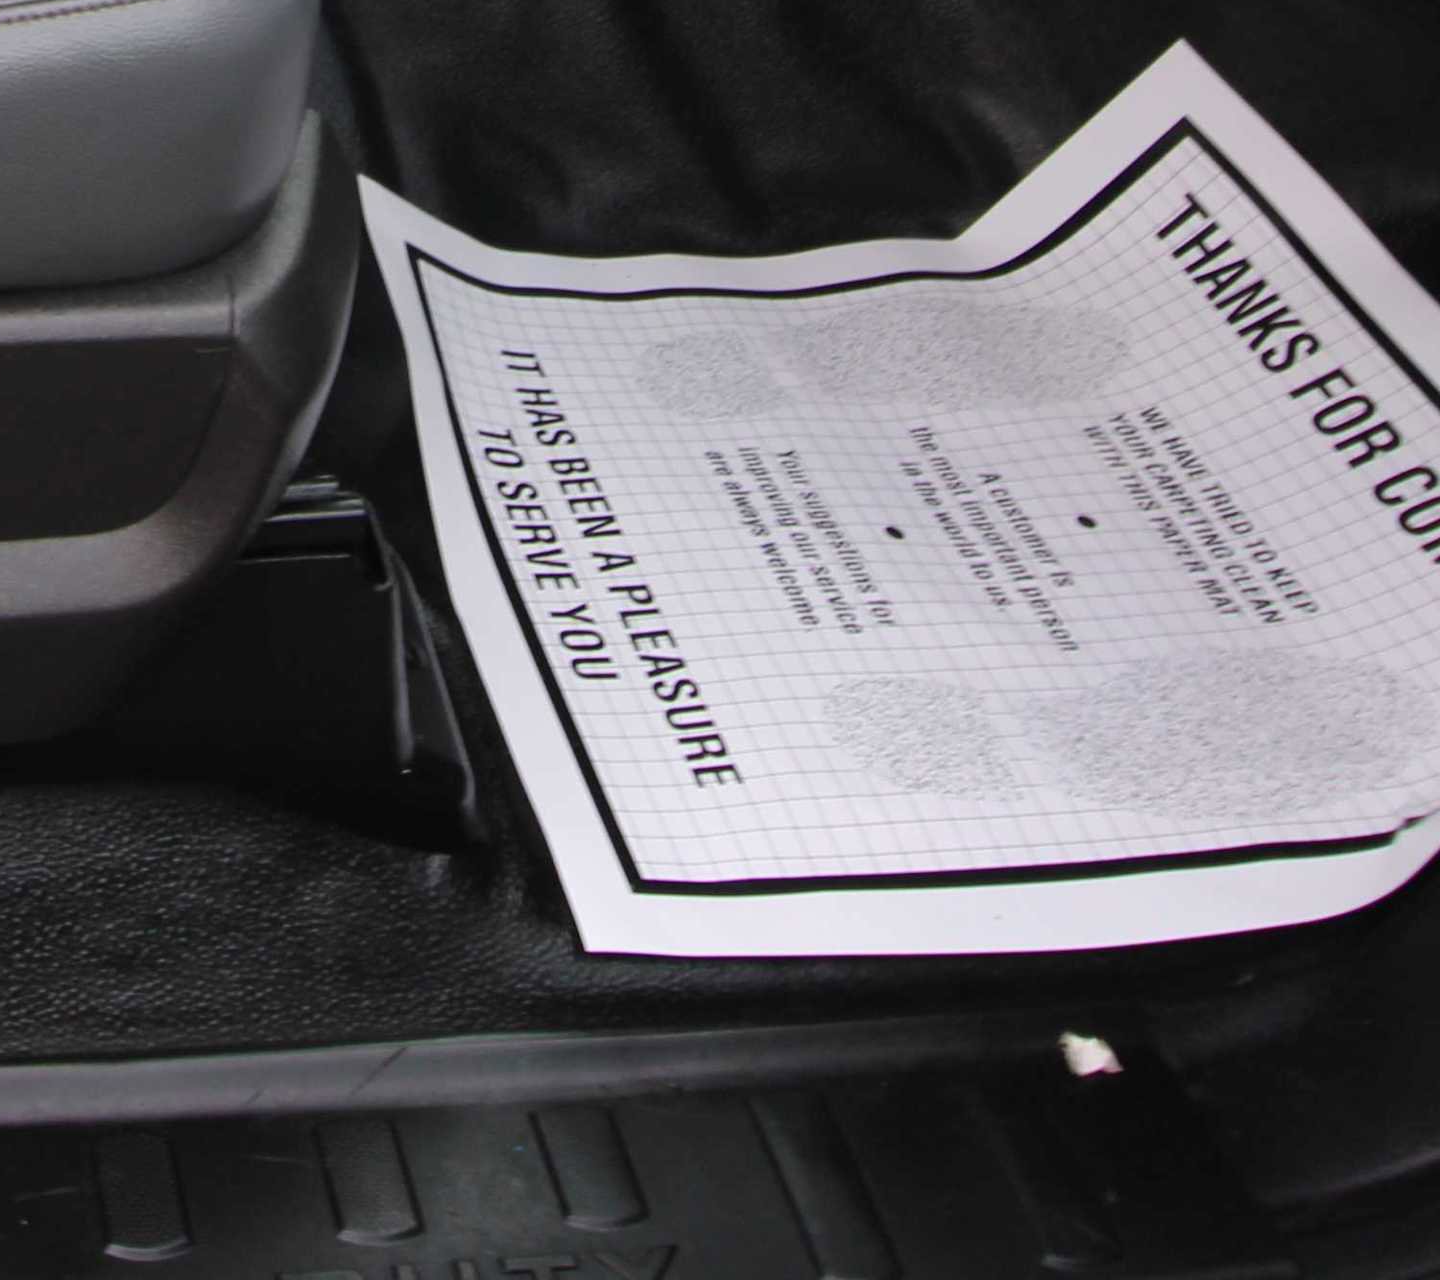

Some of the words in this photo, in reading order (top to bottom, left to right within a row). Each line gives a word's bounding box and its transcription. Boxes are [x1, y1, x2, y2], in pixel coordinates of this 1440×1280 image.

[499, 347, 544, 375] IT
[1154, 191, 1324, 381] THANKS
[1287, 362, 1409, 471] FOR
[476, 425, 526, 468] TO
[516, 385, 577, 446] HAS
[978, 473, 1001, 485] A
[494, 475, 579, 594] SERVE
[548, 455, 623, 540] BEEN
[591, 554, 639, 575] A
[704, 449, 733, 477] are
[722, 477, 771, 538] always
[759, 540, 822, 634] welcome.
[737, 445, 802, 530] improving
[789, 530, 822, 561] our
[808, 563, 867, 636] service
[775, 449, 811, 486] Your
[796, 489, 879, 595] suggestions
[865, 596, 901, 629] for
[899, 461, 925, 478] in
[913, 479, 947, 508] the
[933, 509, 983, 560] world
[968, 562, 996, 582] to
[985, 585, 1015, 612] us.
[909, 426, 941, 453] the
[928, 456, 970, 498] most
[958, 500, 1034, 584] important
[1014, 587, 1080, 654] person
[989, 486, 1061, 565] customer
[1082, 425, 1127, 468] WITH
[1118, 469, 1162, 512] THIS
[1148, 513, 1209, 576] PAPER
[1196, 576, 1243, 617] MAT
[1107, 411, 1156, 462] YOUR
[1143, 459, 1235, 560] CARPETING
[1223, 560, 1286, 627] CLEAN
[1139, 404, 1173, 436] WE
[1162, 434, 1213, 483] HAVE
[1199, 480, 1256, 538] TRIED
[1244, 536, 1280, 566] TO
[1266, 563, 1320, 618] KEEP
[549, 600, 620, 683] YOU
[1048, 571, 1075, 589] is
[607, 581, 744, 793] PLEASURE
